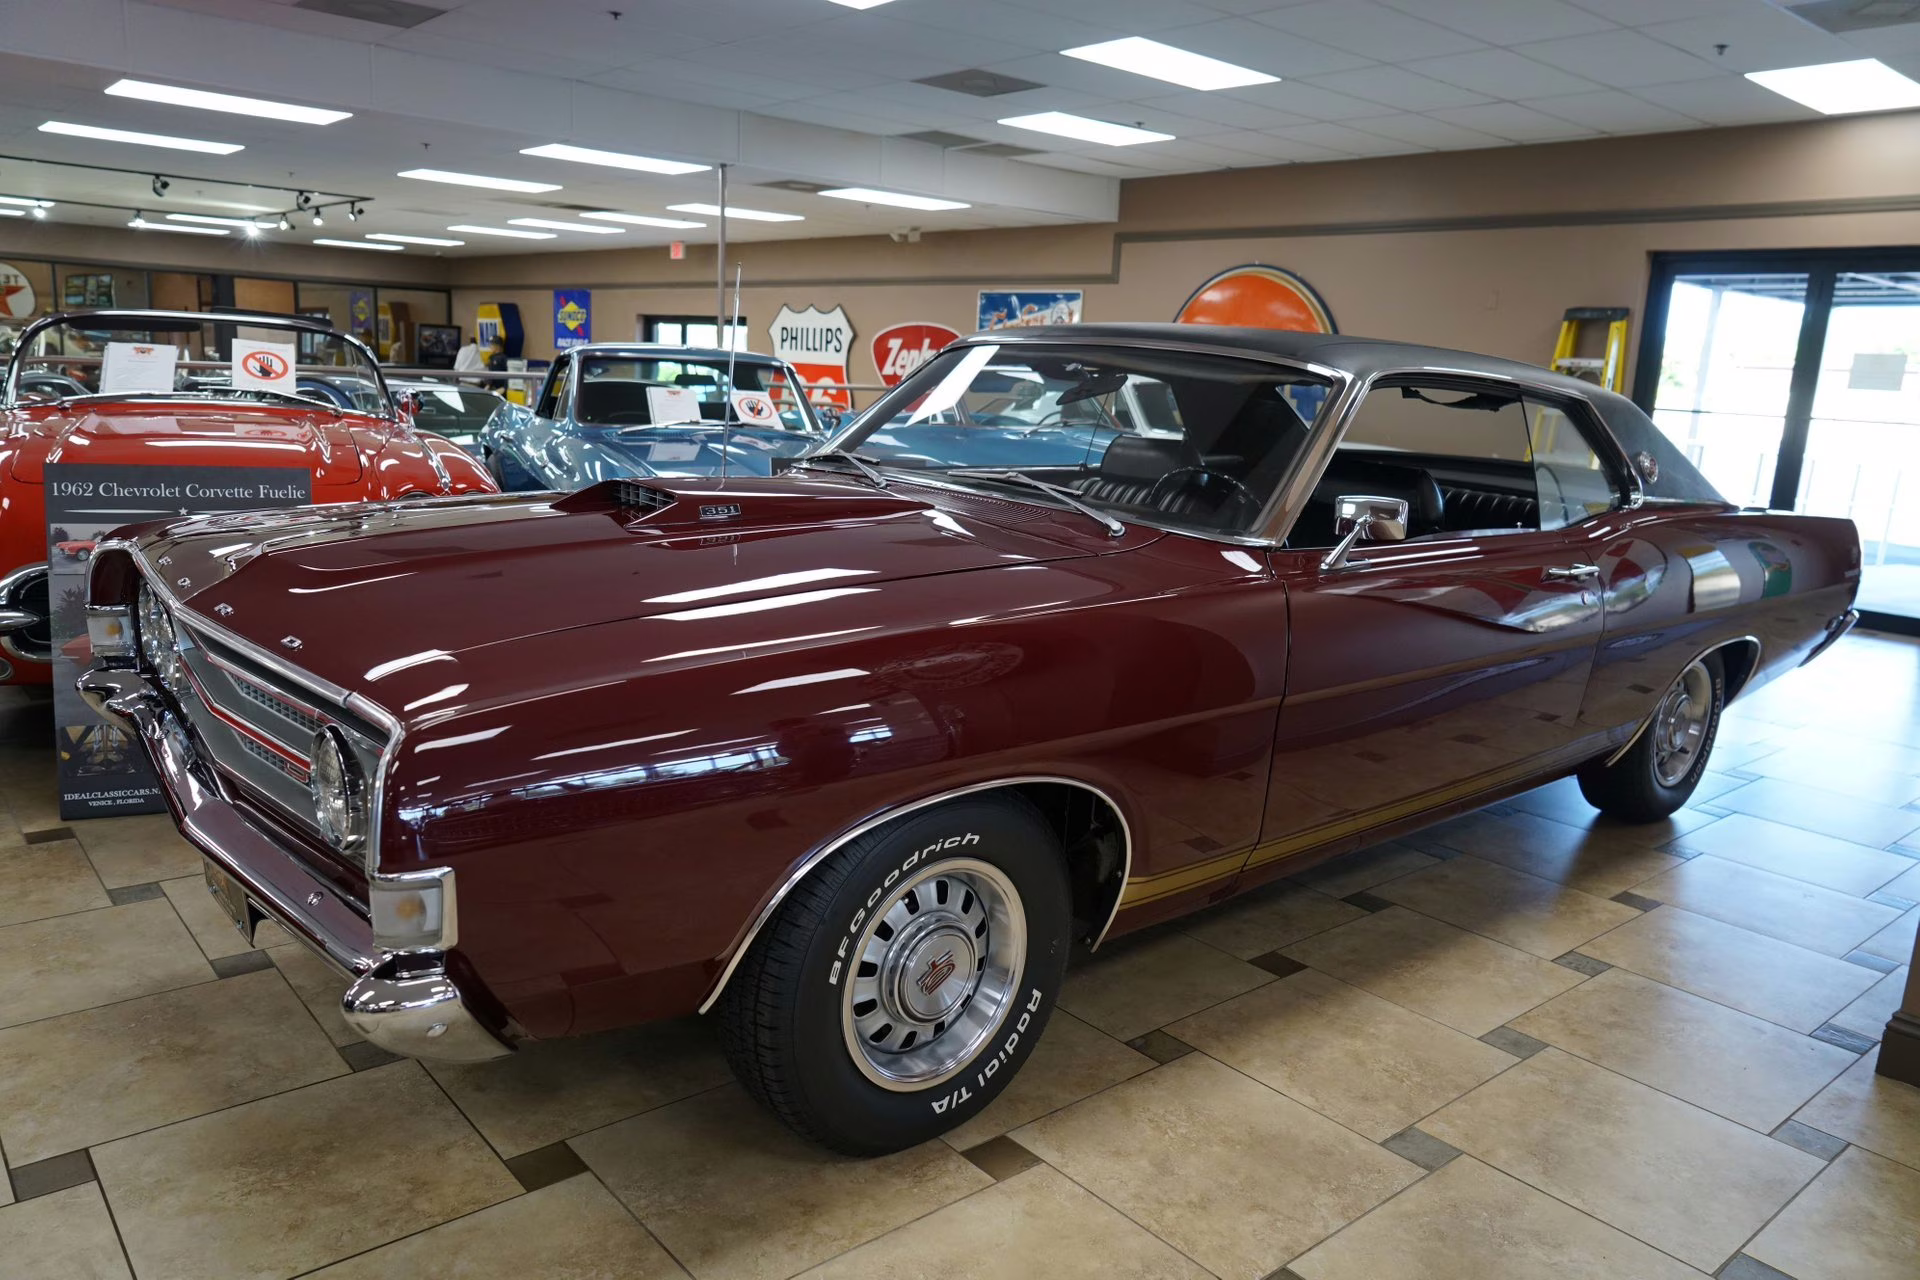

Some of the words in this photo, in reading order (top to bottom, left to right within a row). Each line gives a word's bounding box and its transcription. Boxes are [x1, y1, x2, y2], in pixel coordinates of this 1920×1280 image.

[781, 326, 843, 353] PHILLIPS
[882, 338, 938, 381] Zeph
[52, 482, 93, 497] 1962
[99, 482, 180, 498] Chevrolet
[186, 484, 253, 499] Corvette
[259, 484, 306, 499] Fuelie
[705, 505, 736, 515] 351
[829, 832, 980, 986] BFGoodrich
[978, 988, 1043, 1087] Radial
[931, 1088, 973, 1115] T/A
